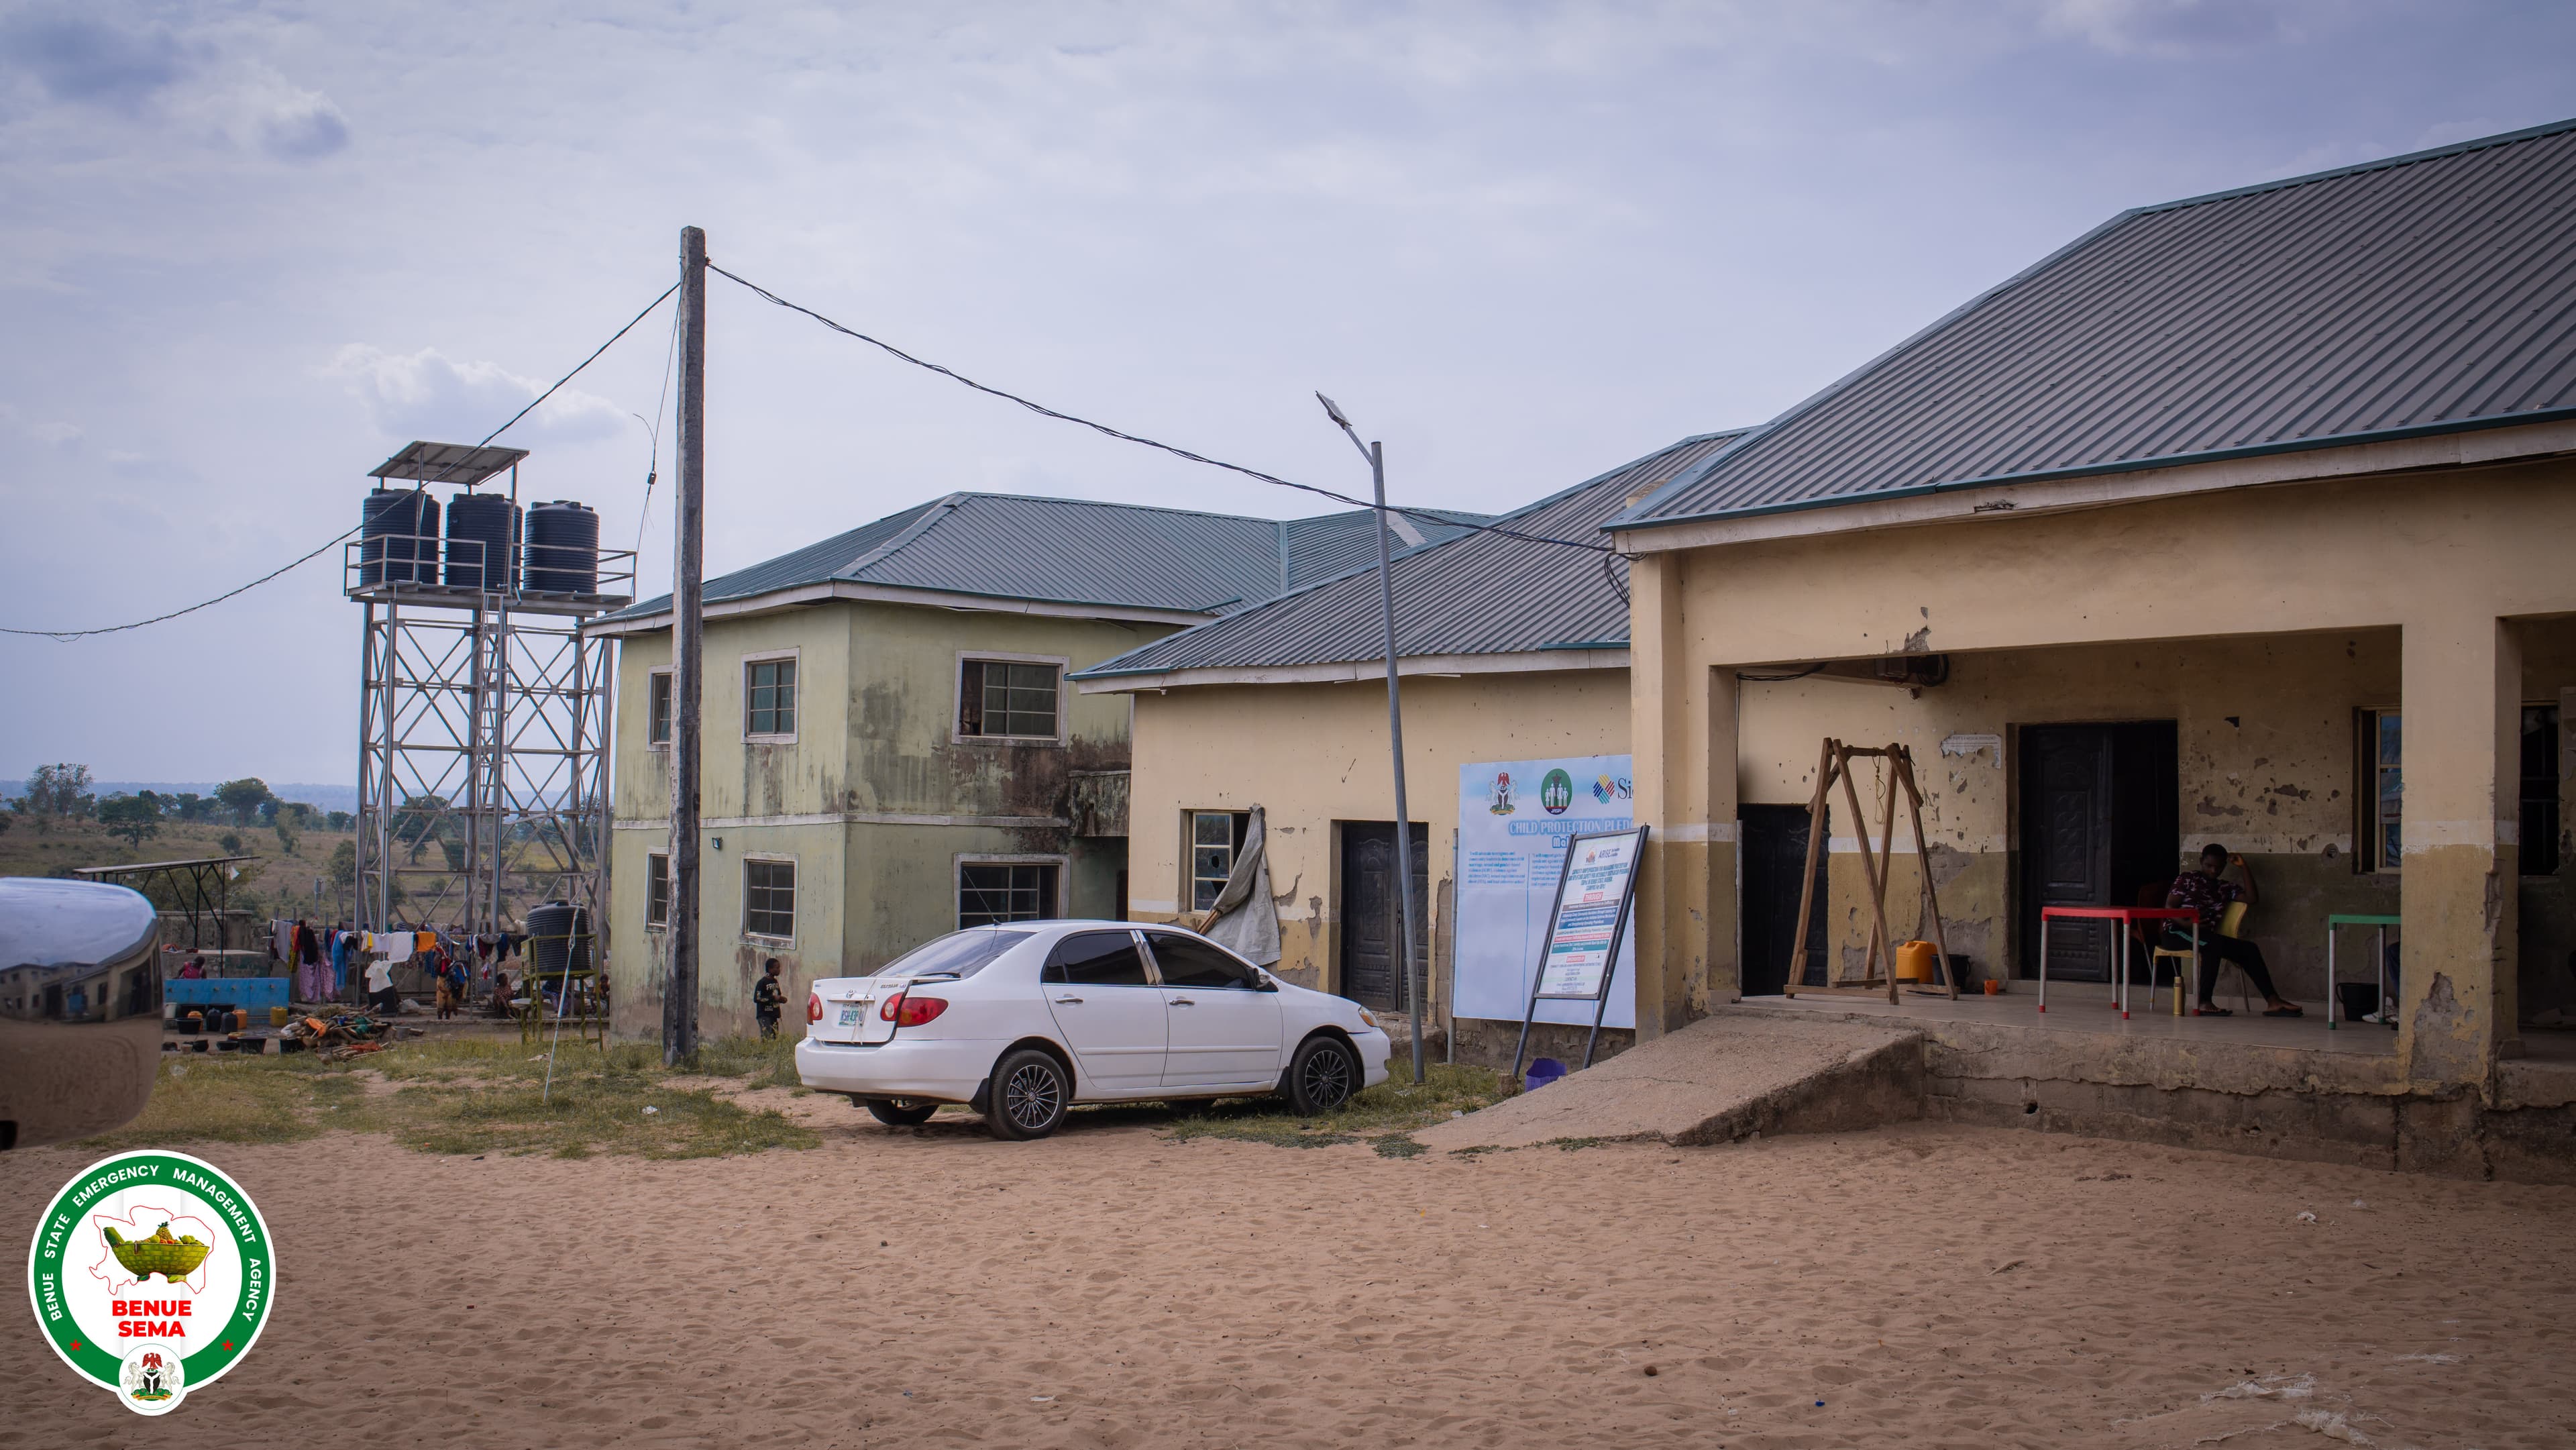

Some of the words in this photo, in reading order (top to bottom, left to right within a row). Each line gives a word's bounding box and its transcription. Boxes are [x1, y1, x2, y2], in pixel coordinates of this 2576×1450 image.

[1617, 778, 1633, 800] Si
[1509, 821, 1538, 834] CHILD
[1540, 820, 1601, 833] PROTECTION
